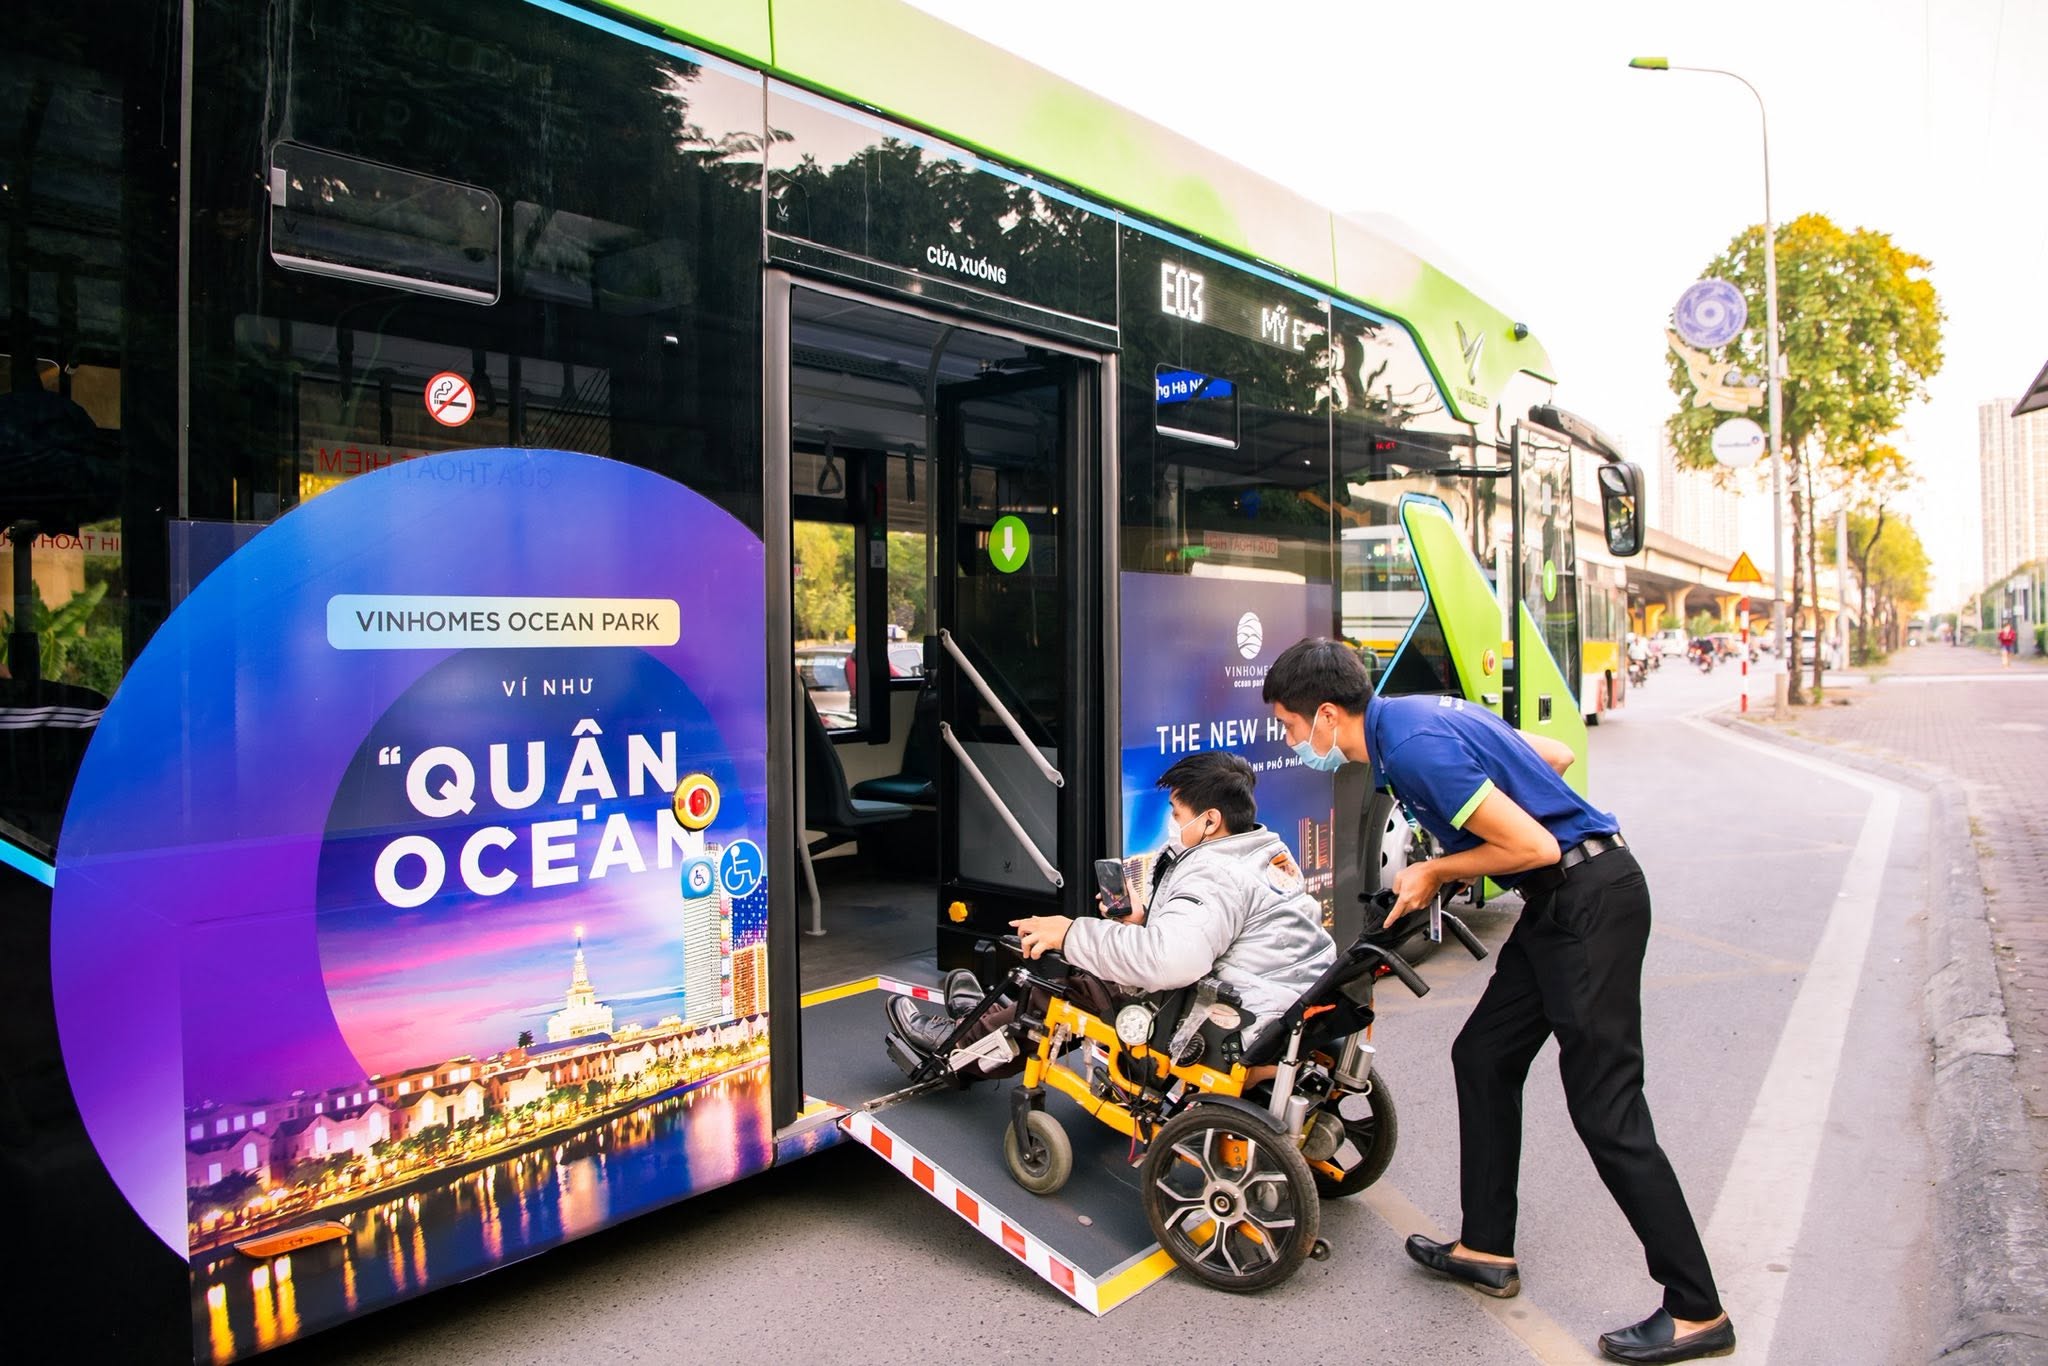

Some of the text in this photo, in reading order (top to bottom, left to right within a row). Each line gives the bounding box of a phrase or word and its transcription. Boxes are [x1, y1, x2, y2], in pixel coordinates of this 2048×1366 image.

[927, 244, 1007, 284] CỬA XUỐNG
[1161, 261, 1204, 323] E03
[1172, 381, 1187, 394] Hà
[355, 610, 660, 632] VINHOMES OCEAN PARK
[1225, 665, 1273, 677] VINHOME
[502, 676, 594, 697] VÍ NHƯ
[1233, 680, 1251, 688] ocean
[1156, 722, 1200, 755] THE
[1210, 718, 1258, 748] NEW
[1267, 755, 1283, 771] PHỐ
[374, 807, 705, 909] OCEAN
